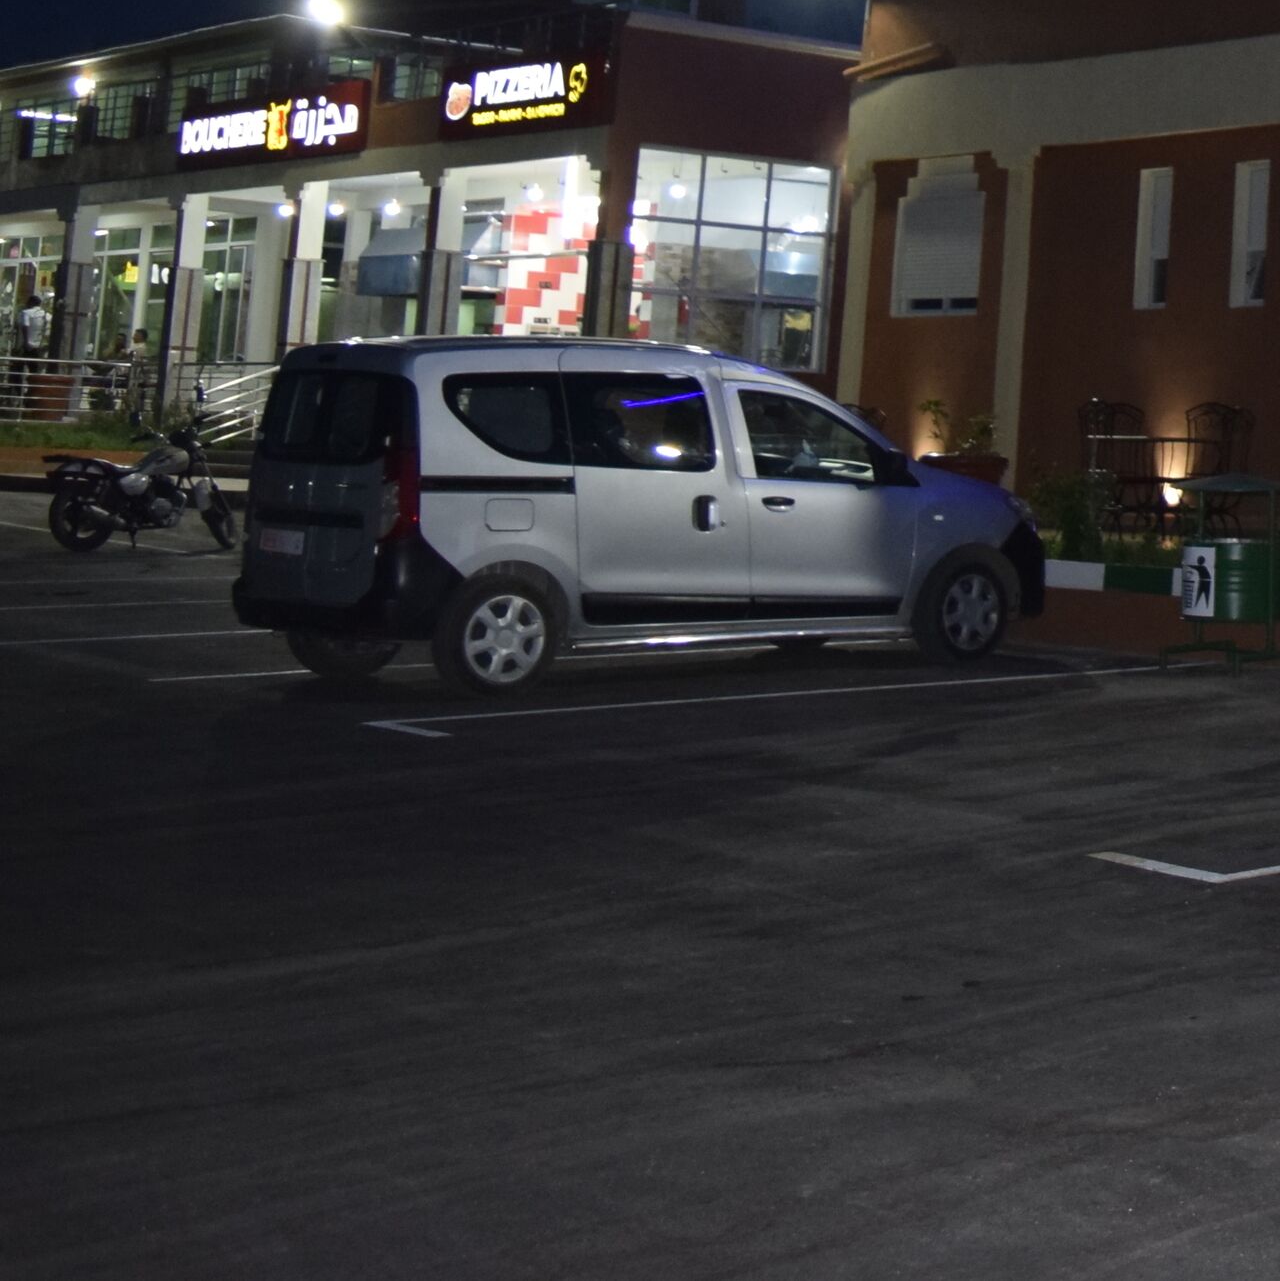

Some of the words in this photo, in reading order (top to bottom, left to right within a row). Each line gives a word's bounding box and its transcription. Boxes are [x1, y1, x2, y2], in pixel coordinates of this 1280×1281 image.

[473, 61, 566, 106] PIZZERIA
[180, 110, 268, 154] BOUCHERIE
[292, 95, 359, 146] مجزرة
